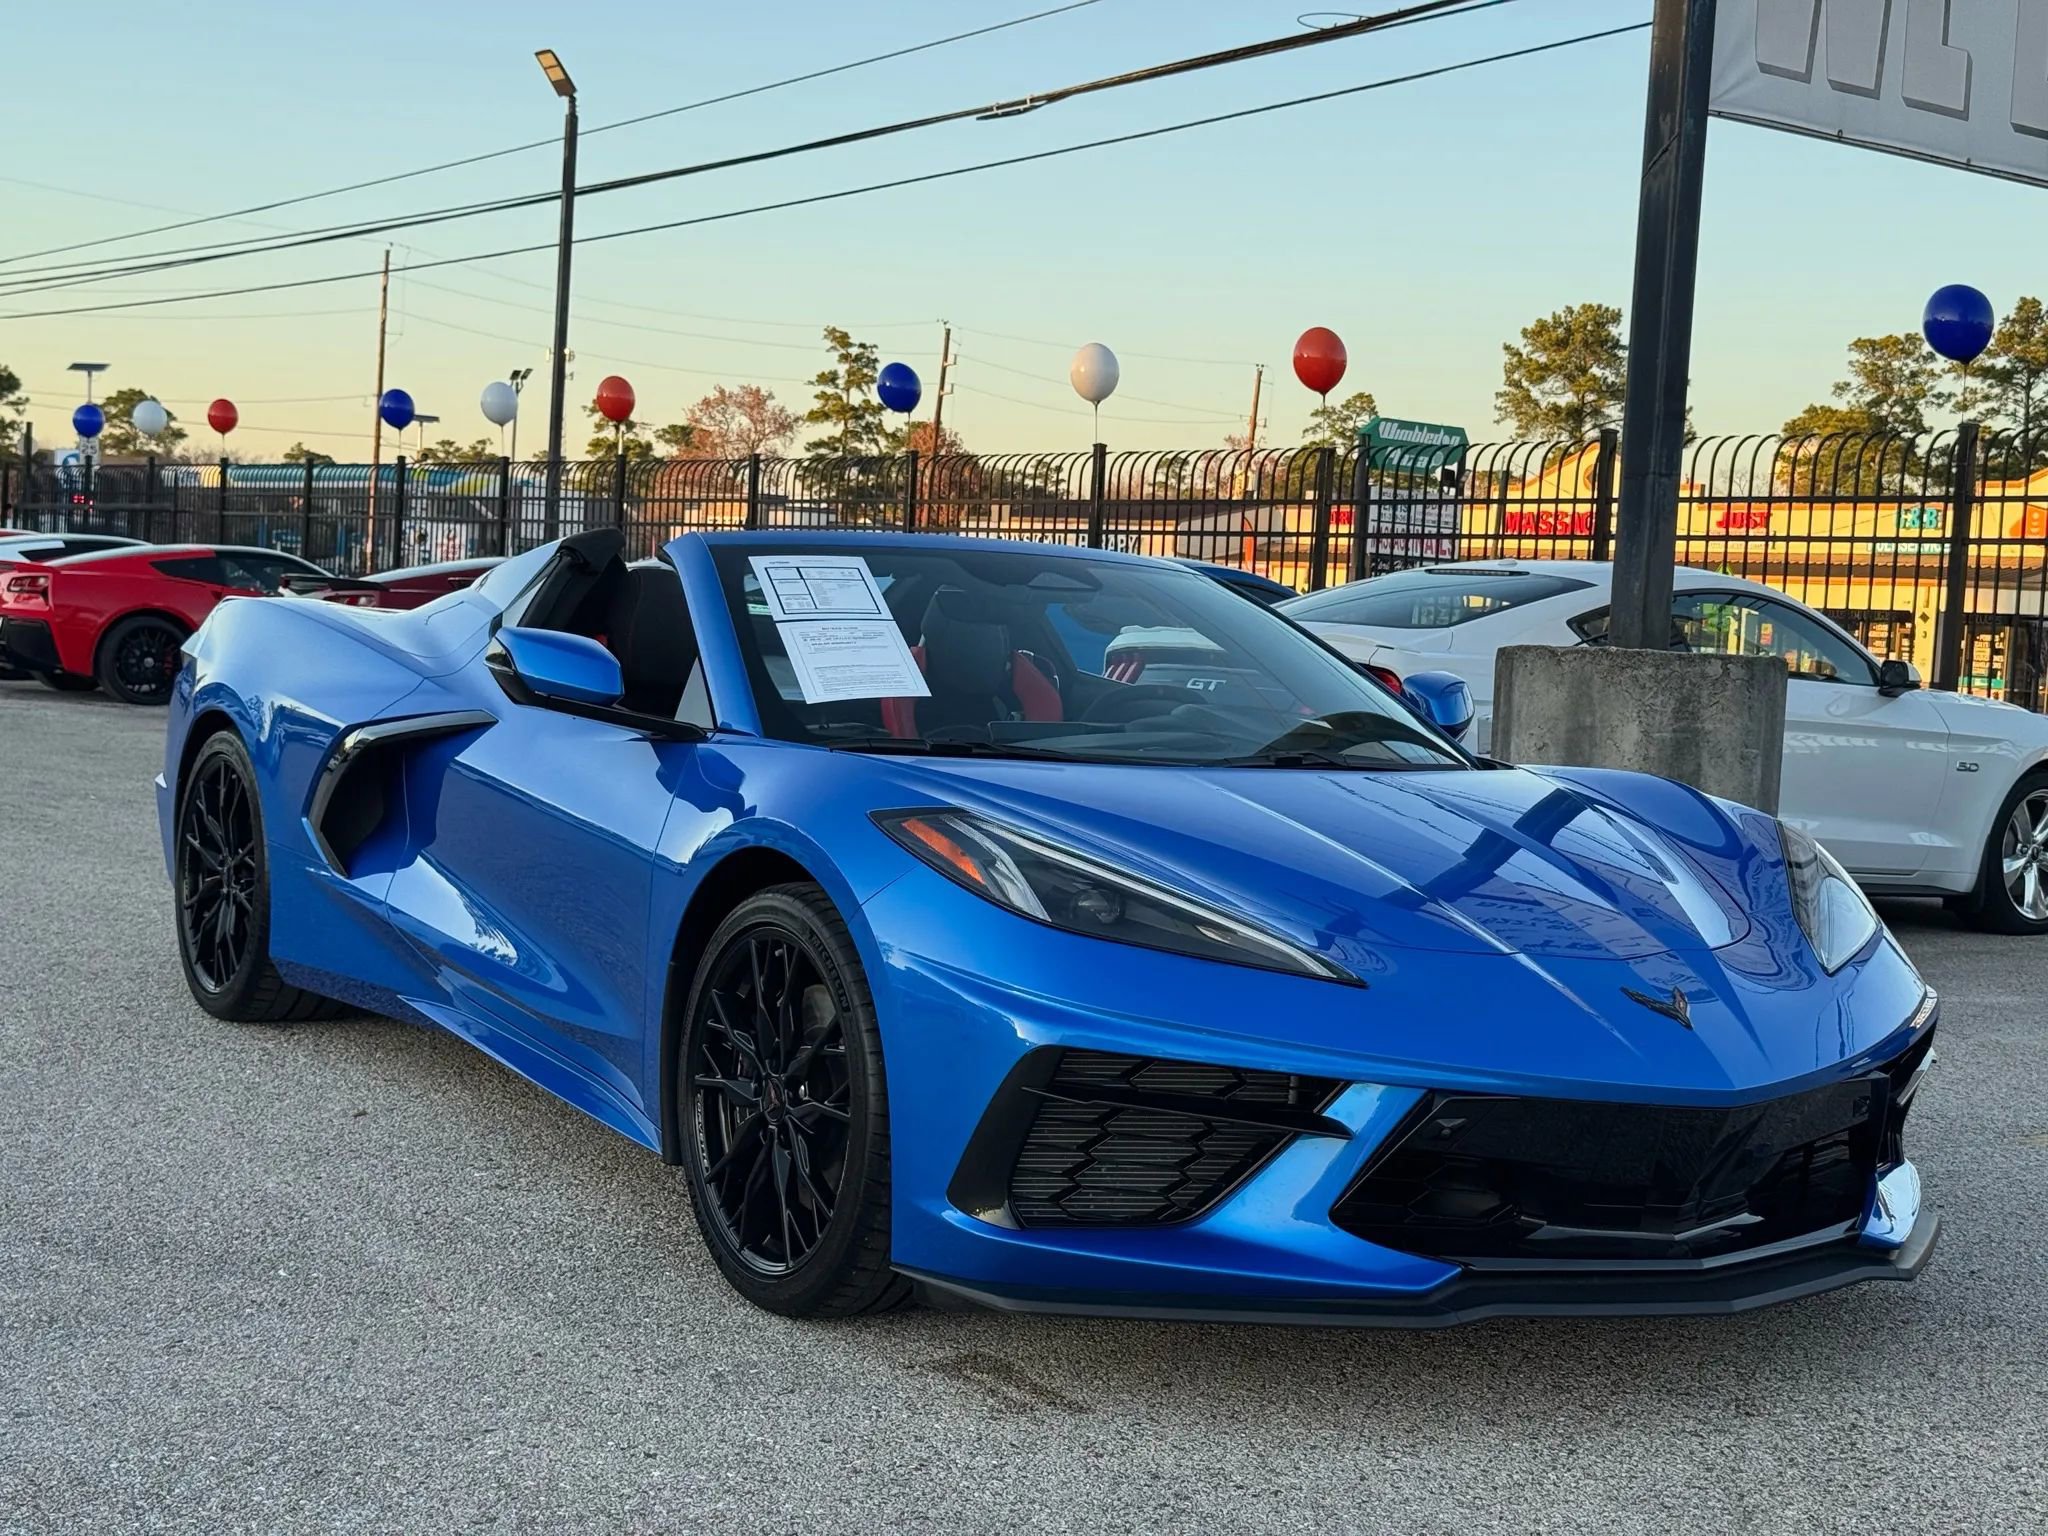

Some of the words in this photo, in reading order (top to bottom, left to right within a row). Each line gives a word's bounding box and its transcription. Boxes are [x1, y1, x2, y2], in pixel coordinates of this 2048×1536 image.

[1378, 421, 1461, 447] Wimbledon
[1504, 511, 1597, 535] MASSA
[1716, 511, 1769, 529] JUST
[1186, 677, 1227, 692] GT
[809, 931, 851, 1010] MICHELIN
